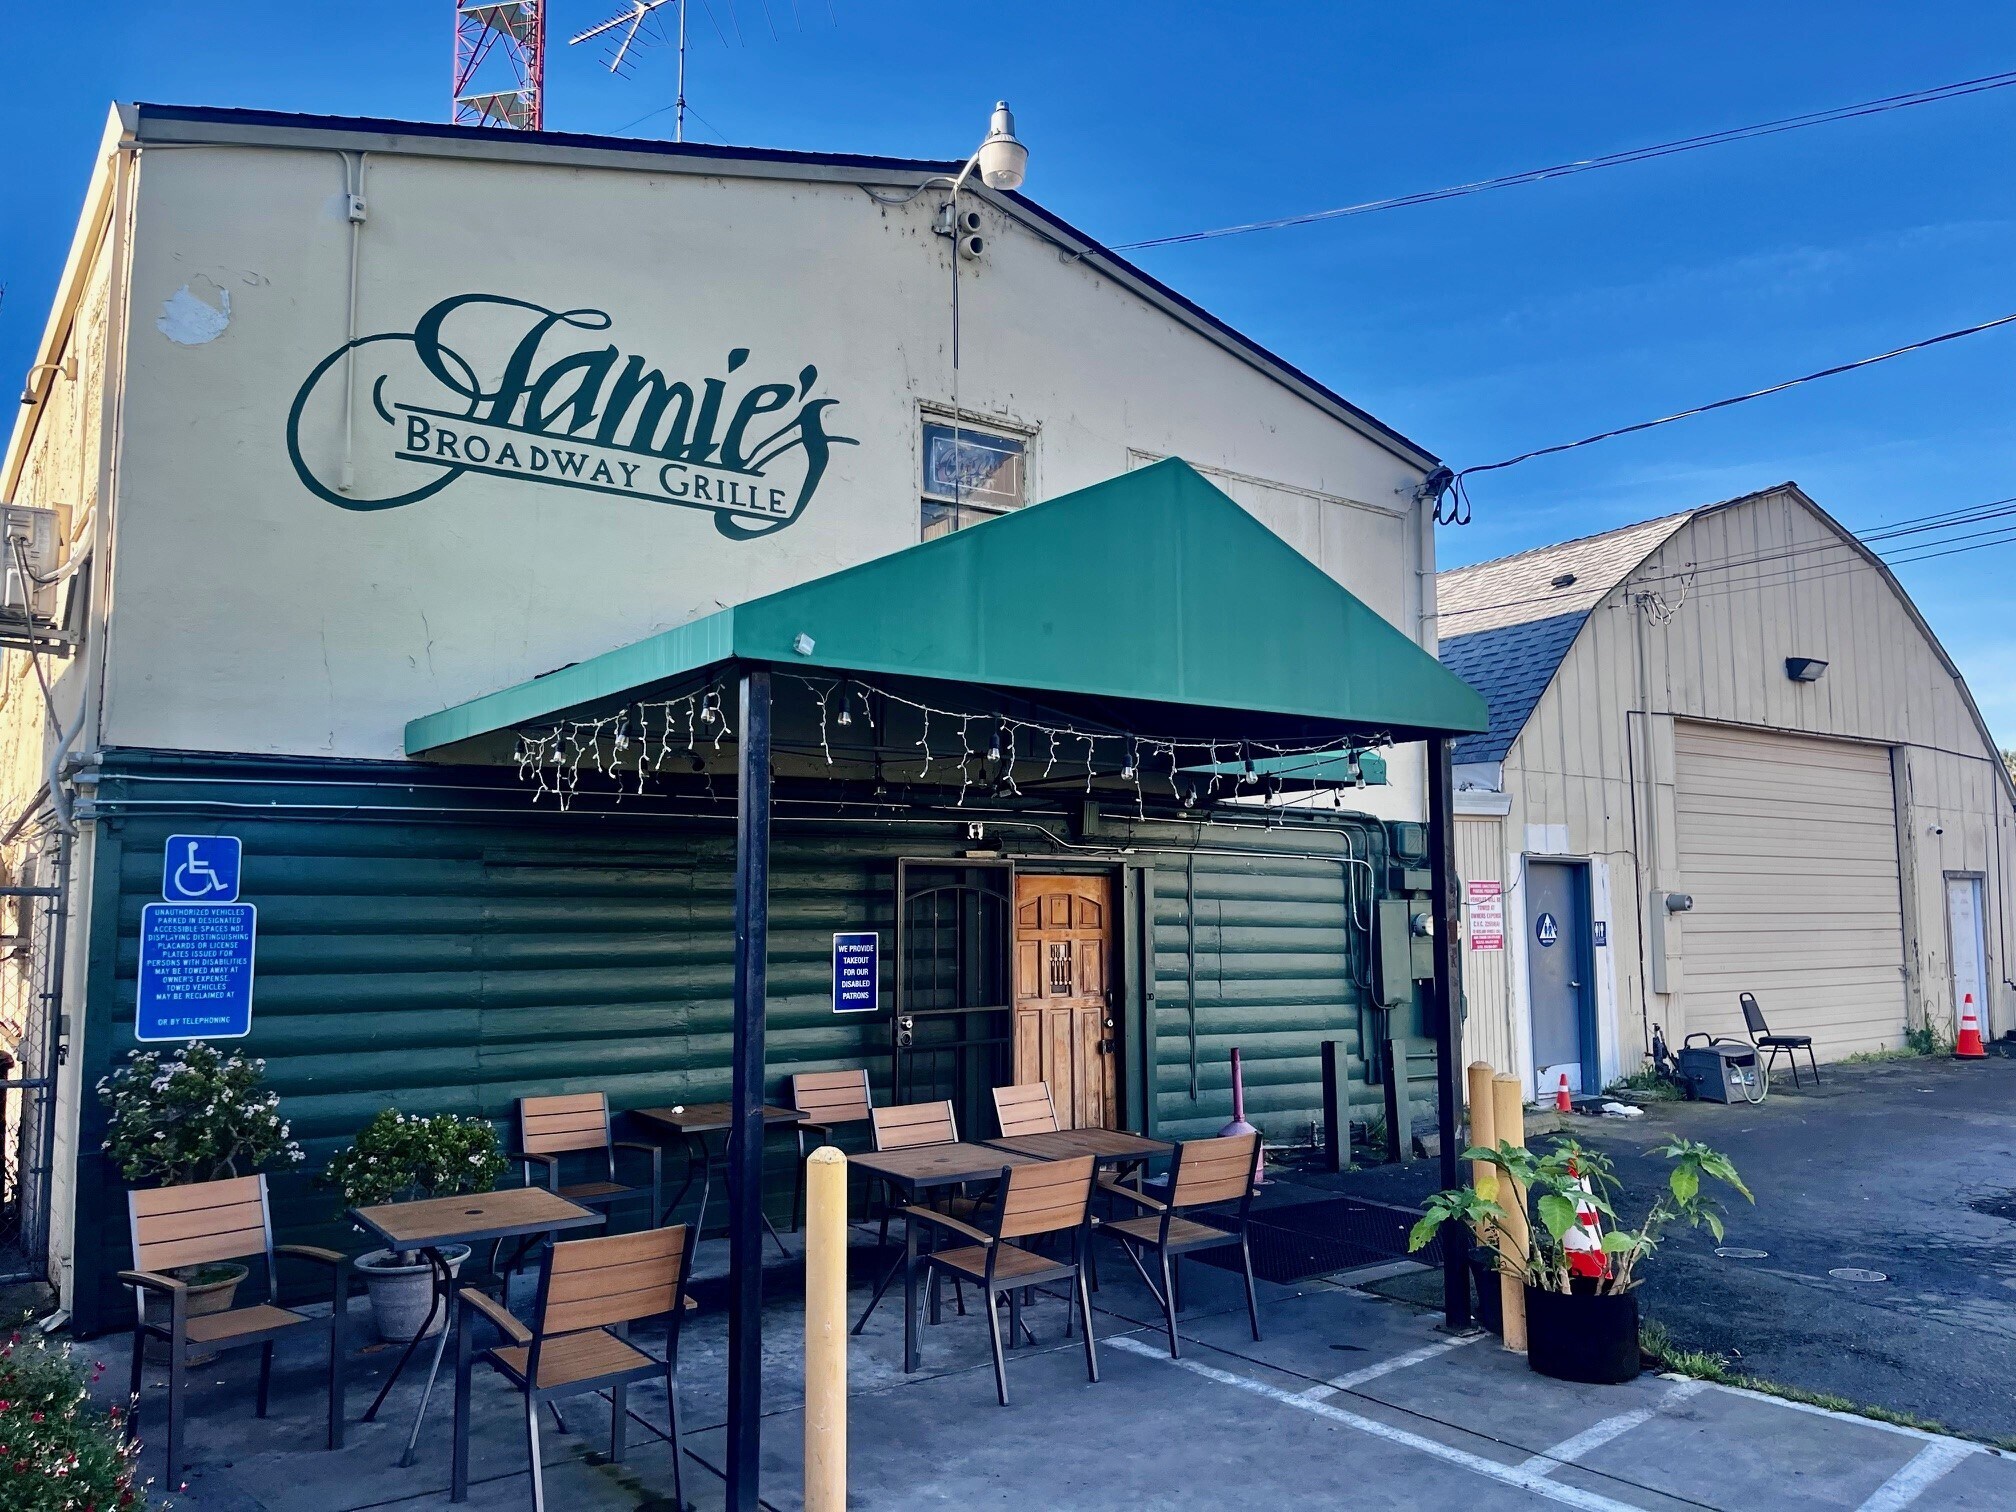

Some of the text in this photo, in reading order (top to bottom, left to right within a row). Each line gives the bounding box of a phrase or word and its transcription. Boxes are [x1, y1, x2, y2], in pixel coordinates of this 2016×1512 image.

[287, 293, 860, 541] Jamie's
[407, 415, 787, 514] BROADWAY GRILLE
[838, 944, 874, 953] WE PROVIDE
[843, 956, 869, 964] TAKEOUT
[843, 968, 869, 976] FOR OUR
[192, 983, 226, 991] VEHICLES
[841, 979, 871, 988] DISABLED
[842, 992, 869, 1000] PATRONS
[170, 1018, 180, 1026] BY
[182, 1016, 231, 1025] TELEPHONING
